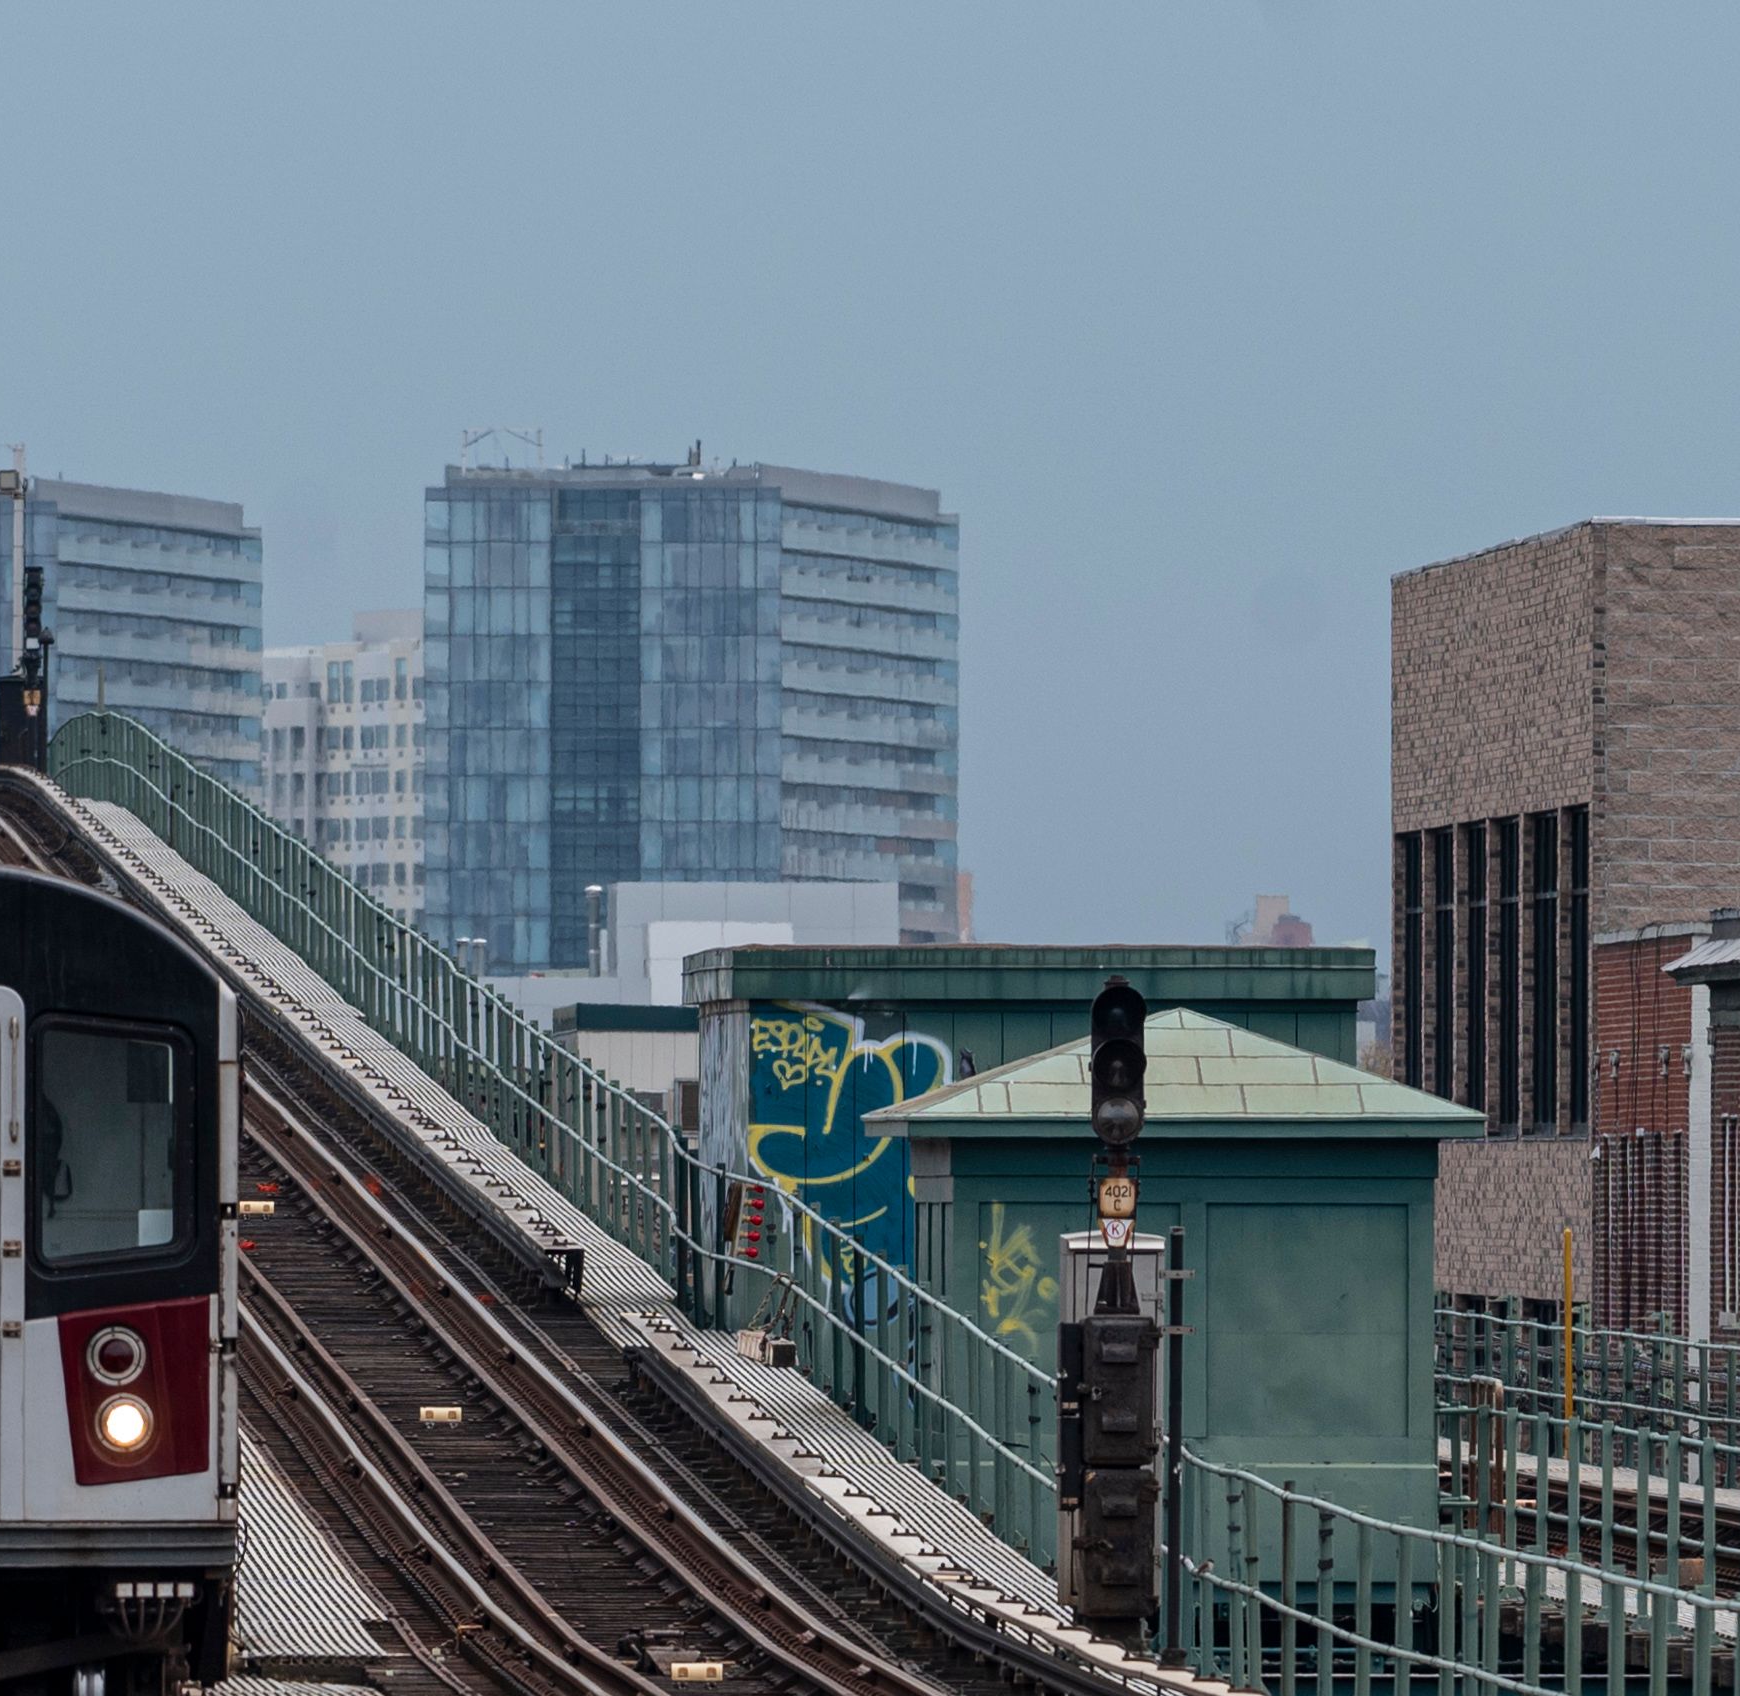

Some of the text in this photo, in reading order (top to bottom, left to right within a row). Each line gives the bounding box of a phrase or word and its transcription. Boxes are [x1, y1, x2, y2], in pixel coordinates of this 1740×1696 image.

[1105, 1185, 1132, 1198] 4021
[1113, 1198, 1121, 1211] C
[1111, 1223, 1120, 1235] K
